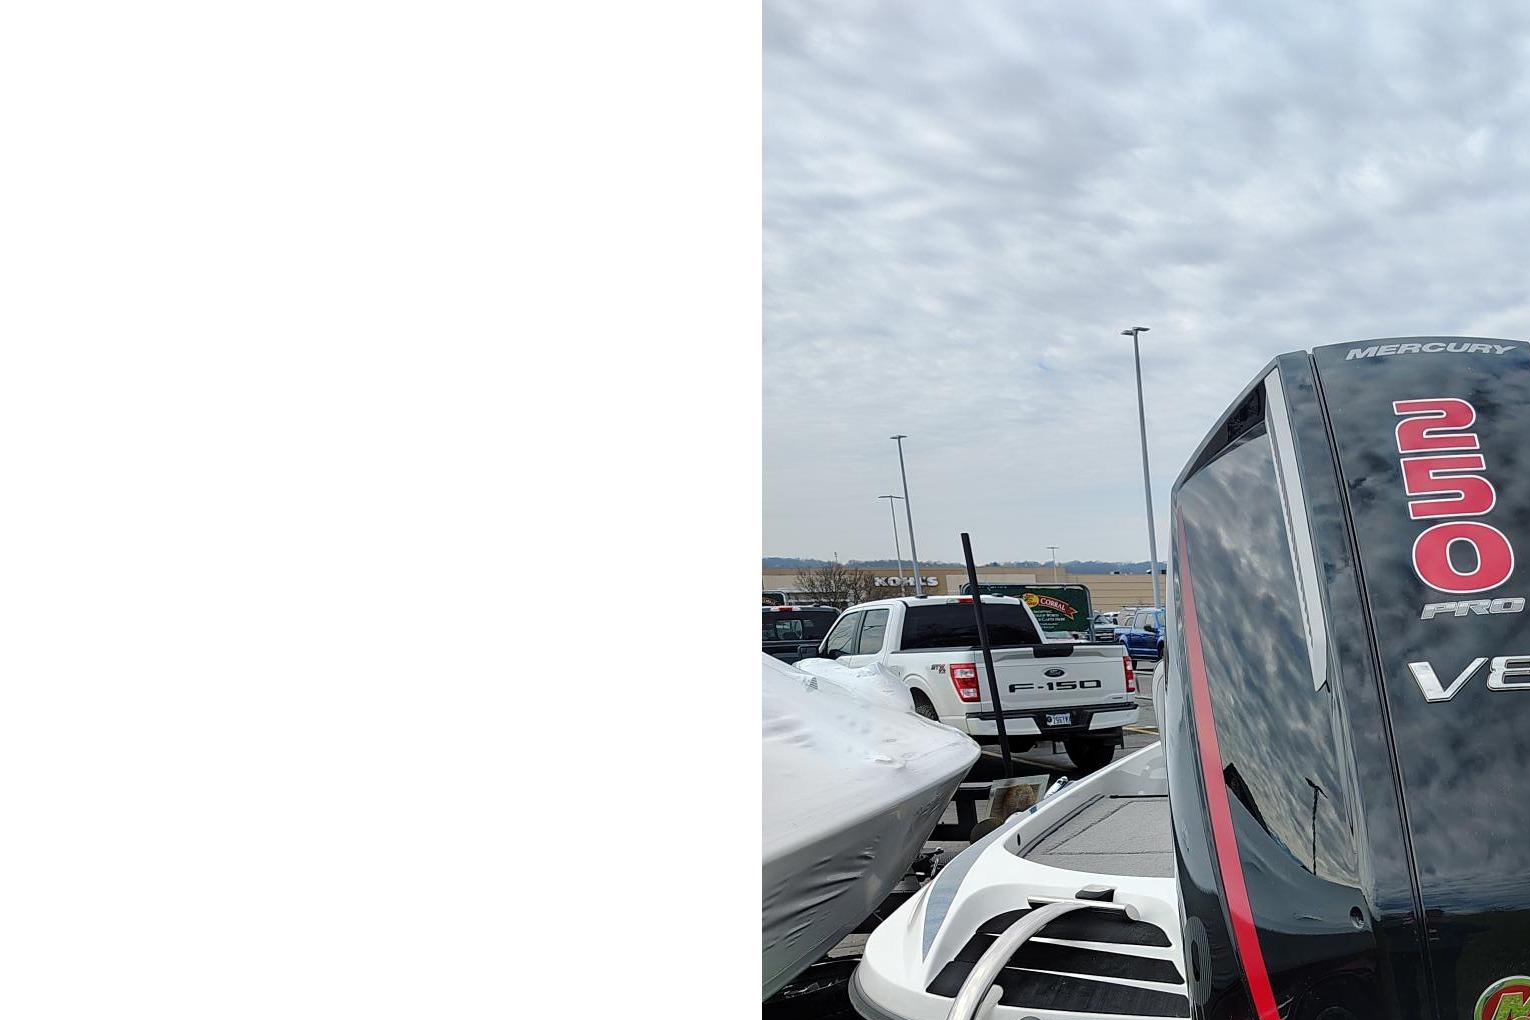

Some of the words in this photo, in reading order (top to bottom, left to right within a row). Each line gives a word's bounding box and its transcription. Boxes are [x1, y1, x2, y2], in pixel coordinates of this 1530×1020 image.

[1345, 342, 1517, 361] MERCURY
[1392, 397, 1515, 593] 250
[1420, 597, 1526, 620] PRO
[1008, 679, 1102, 693] F-150
